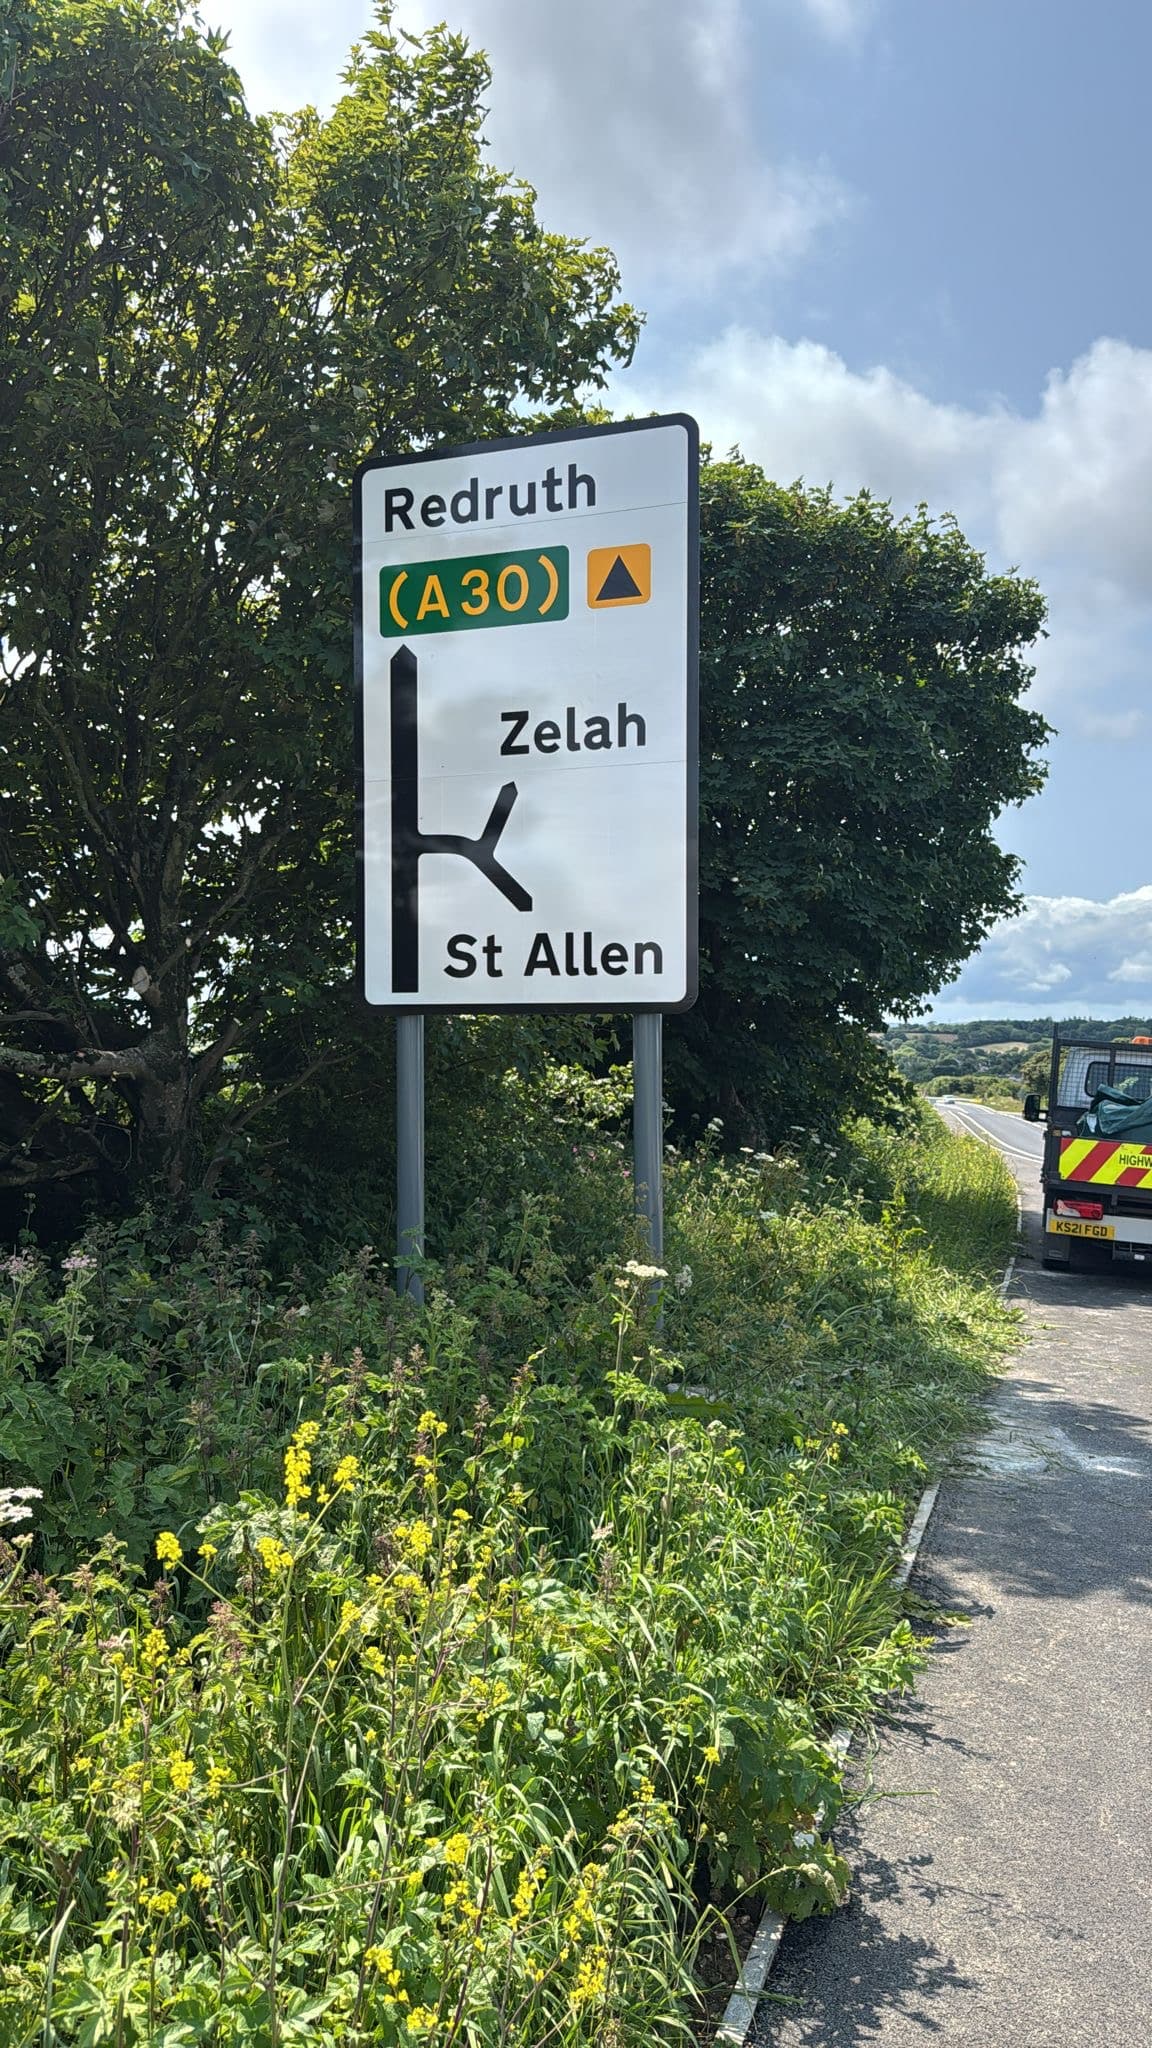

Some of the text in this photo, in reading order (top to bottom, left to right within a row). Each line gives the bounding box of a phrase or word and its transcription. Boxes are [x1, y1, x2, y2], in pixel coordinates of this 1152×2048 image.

[384, 463, 597, 533] Redruth
[500, 702, 647, 756] Zelah
[443, 931, 664, 979] St Allen
[1056, 1221, 1108, 1237] KS21 FGD
